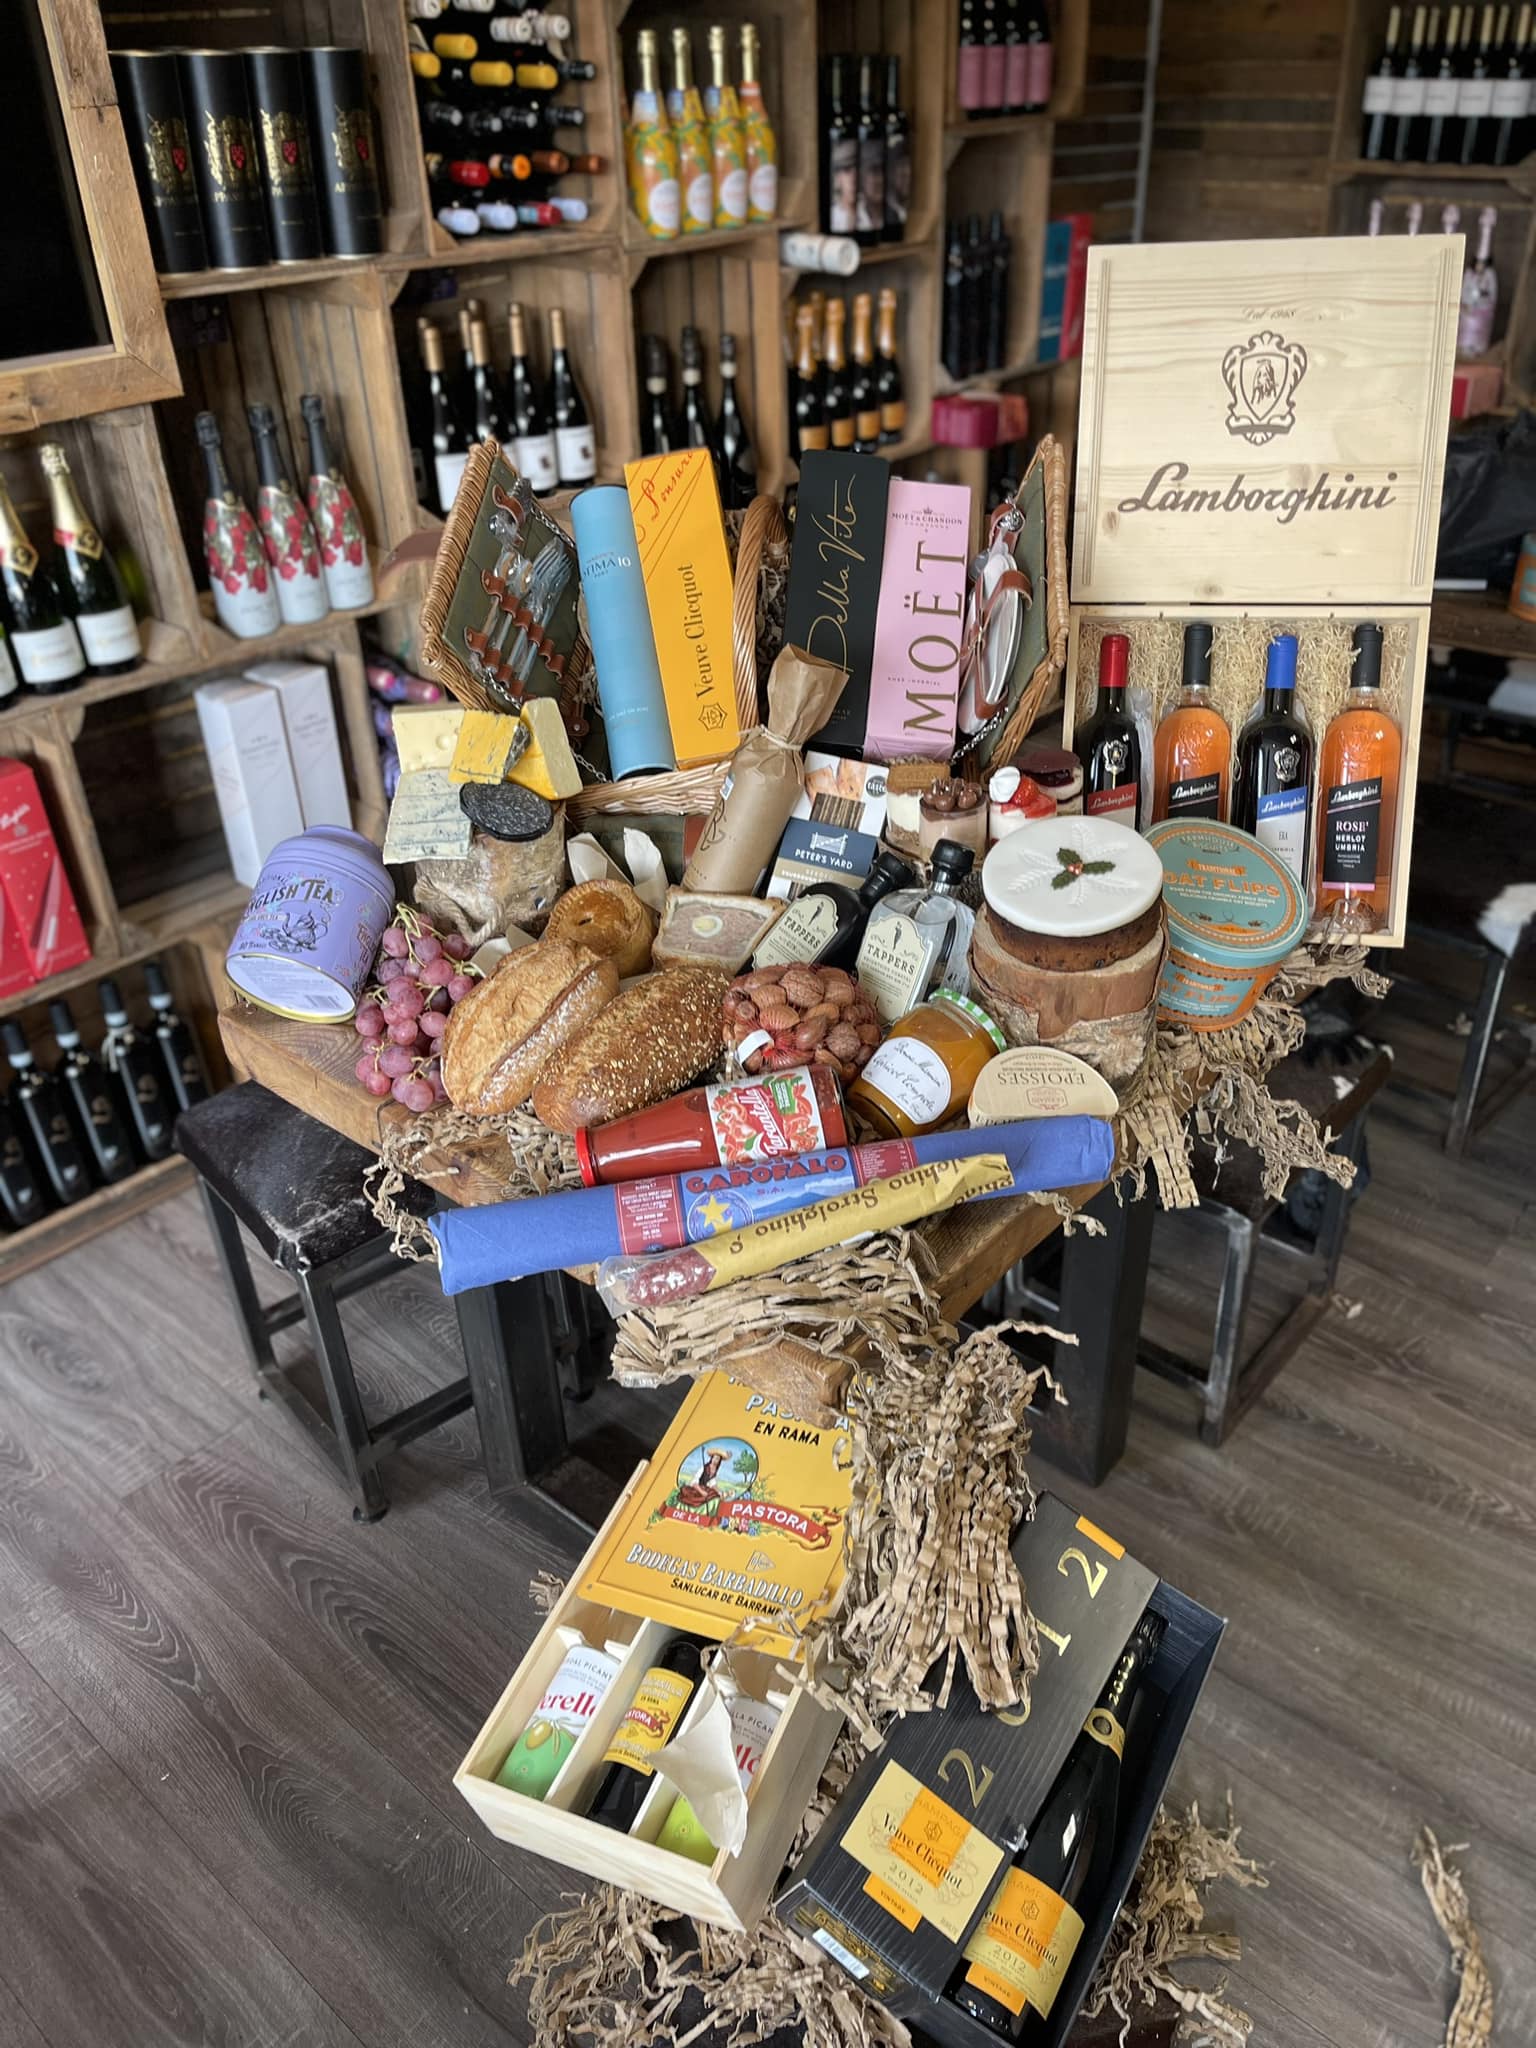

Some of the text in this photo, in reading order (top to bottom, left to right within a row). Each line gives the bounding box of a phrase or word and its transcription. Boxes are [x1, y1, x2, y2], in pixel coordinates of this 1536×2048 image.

[1117, 461, 1398, 524] Lamborghini
[617, 555, 632, 568] 10
[806, 472, 868, 674] Della Vite
[679, 561, 716, 699] Veuve Clicquot
[902, 540, 967, 740] MOËT
[1090, 792, 1135, 811] Lamborghini
[1171, 782, 1218, 800] Lamborghini
[1261, 795, 1305, 814] Lamborghini
[1330, 784, 1379, 804] Lamborghini
[1334, 843, 1366, 852] UMBRIA
[1335, 834, 1366, 844] MERLOT
[794, 848, 853, 870] PETER'S YARD
[300, 879, 334, 904] TEA
[1163, 870, 1281, 898] OAT FLIPS
[783, 915, 822, 950] TAPPERS
[867, 943, 916, 976] TAPPERS
[997, 1072, 1086, 1086] EPOISSES
[686, 1154, 848, 1194] GAROFALO
[755, 1188, 879, 1238] Strolghino
[754, 1421, 821, 1446] EN RAMA
[672, 1509, 700, 1524] DE LA
[731, 1502, 809, 1535] PASTORA
[625, 1542, 804, 1608] BODEGAS BARBADILLO
[671, 1577, 719, 1601] SANLUCAR
[719, 1592, 733, 1605] DE
[583, 1660, 613, 1682] PICANT
[1108, 1651, 1136, 1707] 2012
[747, 1715, 775, 1735] PICAN
[883, 1812, 915, 1848] Veuve
[915, 1840, 963, 1890] Clicquot
[888, 1862, 924, 1894] 2012
[984, 1909, 1059, 1968] euve Clicquot
[993, 1944, 1027, 1973] 2012
